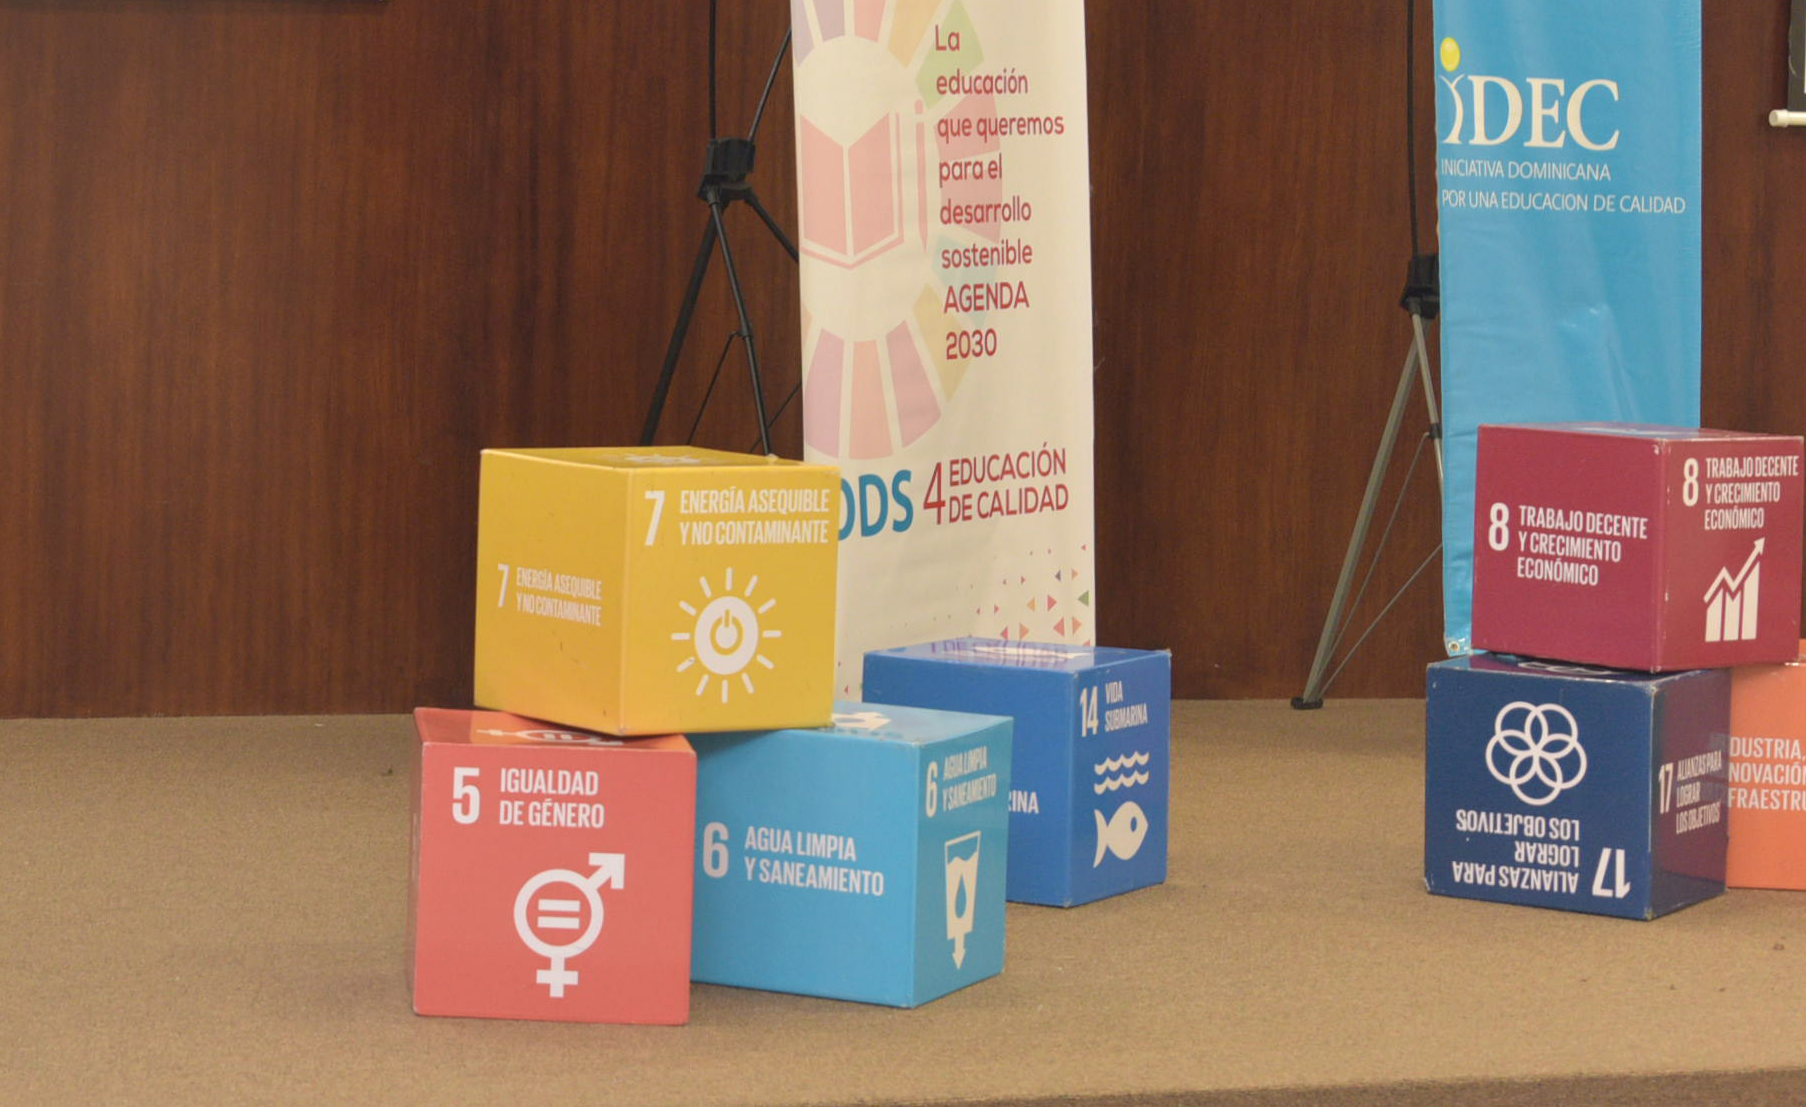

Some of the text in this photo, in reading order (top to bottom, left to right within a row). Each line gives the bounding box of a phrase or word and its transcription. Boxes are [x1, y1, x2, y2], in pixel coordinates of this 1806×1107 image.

[935, 24, 961, 51] La
[936, 68, 1029, 95] educación
[938, 115, 1065, 144] que queremos
[939, 153, 1003, 188] para el
[1442, 158, 1611, 181] INICIATIVA DOMINICANA
[940, 196, 1032, 225] desarrollo
[1442, 189, 1686, 214] POR UNA EDUCACION DE CALIDAD
[941, 238, 1033, 269] sostenible
[944, 281, 1030, 314] AGENDA
[946, 329, 997, 360] 2030
[922, 442, 1066, 525] 4 EDUCACIÓN
[1682, 455, 1799, 507] 8 TRABAJO DECENTE
[1714, 481, 1780, 504] CRECIMIENTO
[645, 486, 830, 547] 7 ENERGÍA ASEQUIBLE
[949, 484, 1069, 523] DE CALIDAD
[1704, 506, 1764, 531] ECONÓMICO
[714, 520, 829, 545] CONTAMINANTE
[1488, 502, 1648, 551] 8 TRABAJO DECENTE
[1529, 532, 1622, 563] CRECIMIENTO
[516, 566, 602, 600] ENERGÍA ASEQUIBLE
[1517, 556, 1599, 586] ECONÓMICO
[535, 596, 602, 627] CONTAMINANTE
[1079, 680, 1124, 737] 14 VIDA
[1104, 702, 1148, 733] SUBMARINA
[452, 766, 599, 825] 5 IGUALDAD
[926, 762, 938, 818] 6
[499, 798, 605, 828] DE GÉNERO
[1456, 809, 1580, 841] LOS OBJETIVOS
[702, 821, 857, 880] 6 AGUA LIMPIA
[1514, 841, 1580, 868] LOGRAR
[759, 858, 884, 897] SANEAMIENTO
[1452, 861, 1579, 894] ALIANZAS PARA
